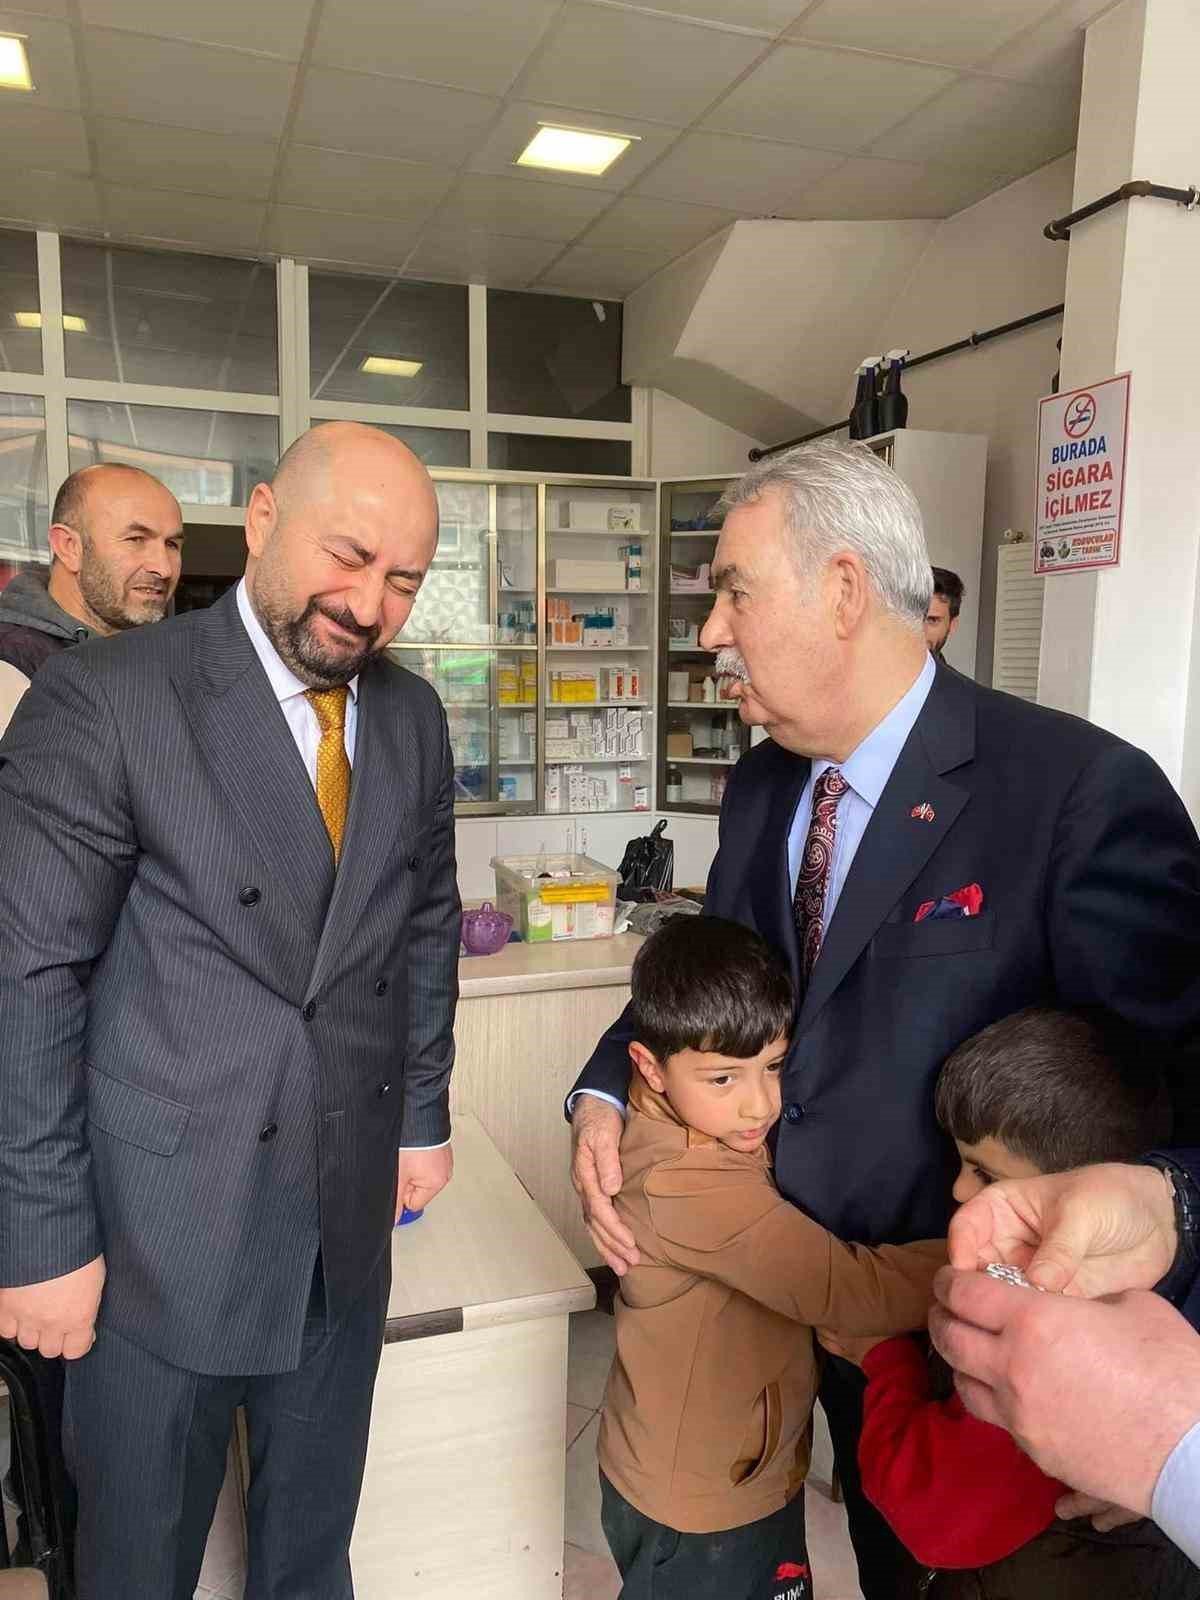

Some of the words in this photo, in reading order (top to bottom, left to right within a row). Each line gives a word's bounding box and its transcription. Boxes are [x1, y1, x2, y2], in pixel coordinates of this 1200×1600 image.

[1052, 436, 1106, 464] BURADA
[1046, 461, 1113, 492] SİGARA
[1045, 489, 1112, 522] İÇİLMEZ
